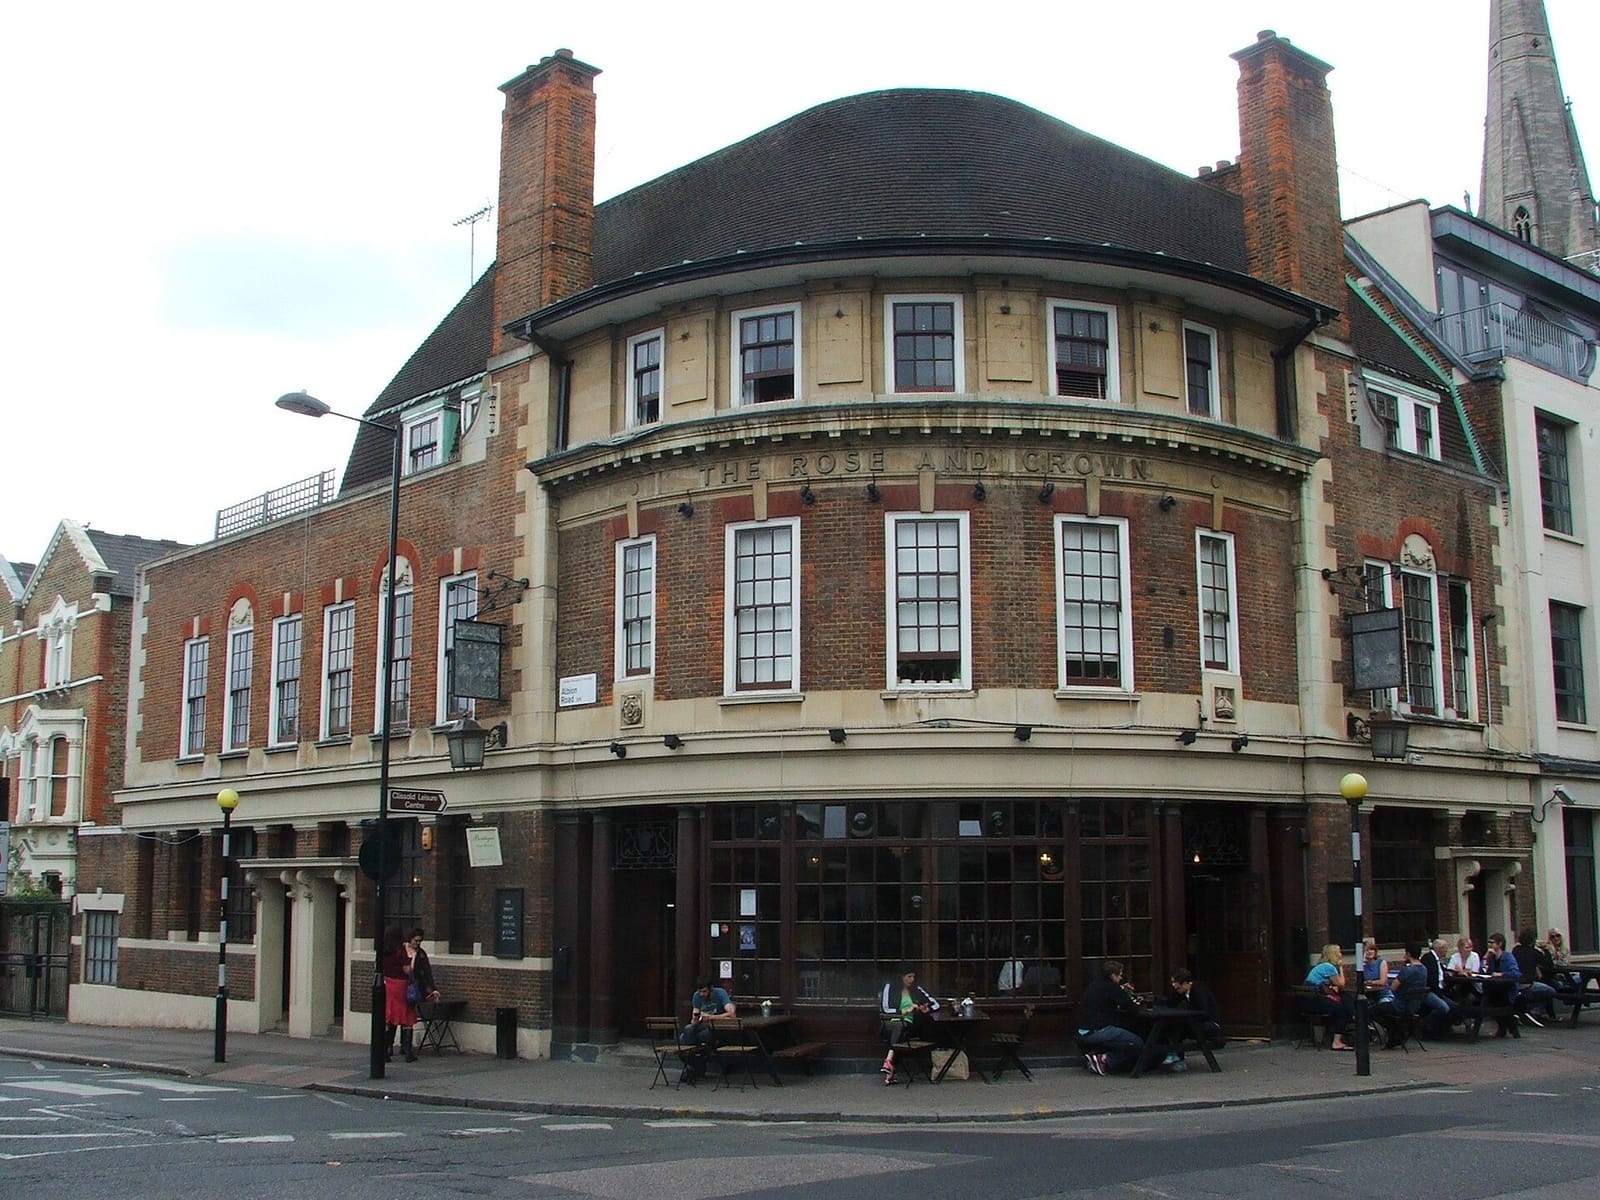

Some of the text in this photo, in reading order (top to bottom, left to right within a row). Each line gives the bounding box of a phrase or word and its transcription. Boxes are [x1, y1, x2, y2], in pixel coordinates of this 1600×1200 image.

[700, 451, 1147, 486] THE ROSE AND CROWN
[391, 792, 439, 801] Clissold Leisure
[404, 801, 425, 809] Centre
